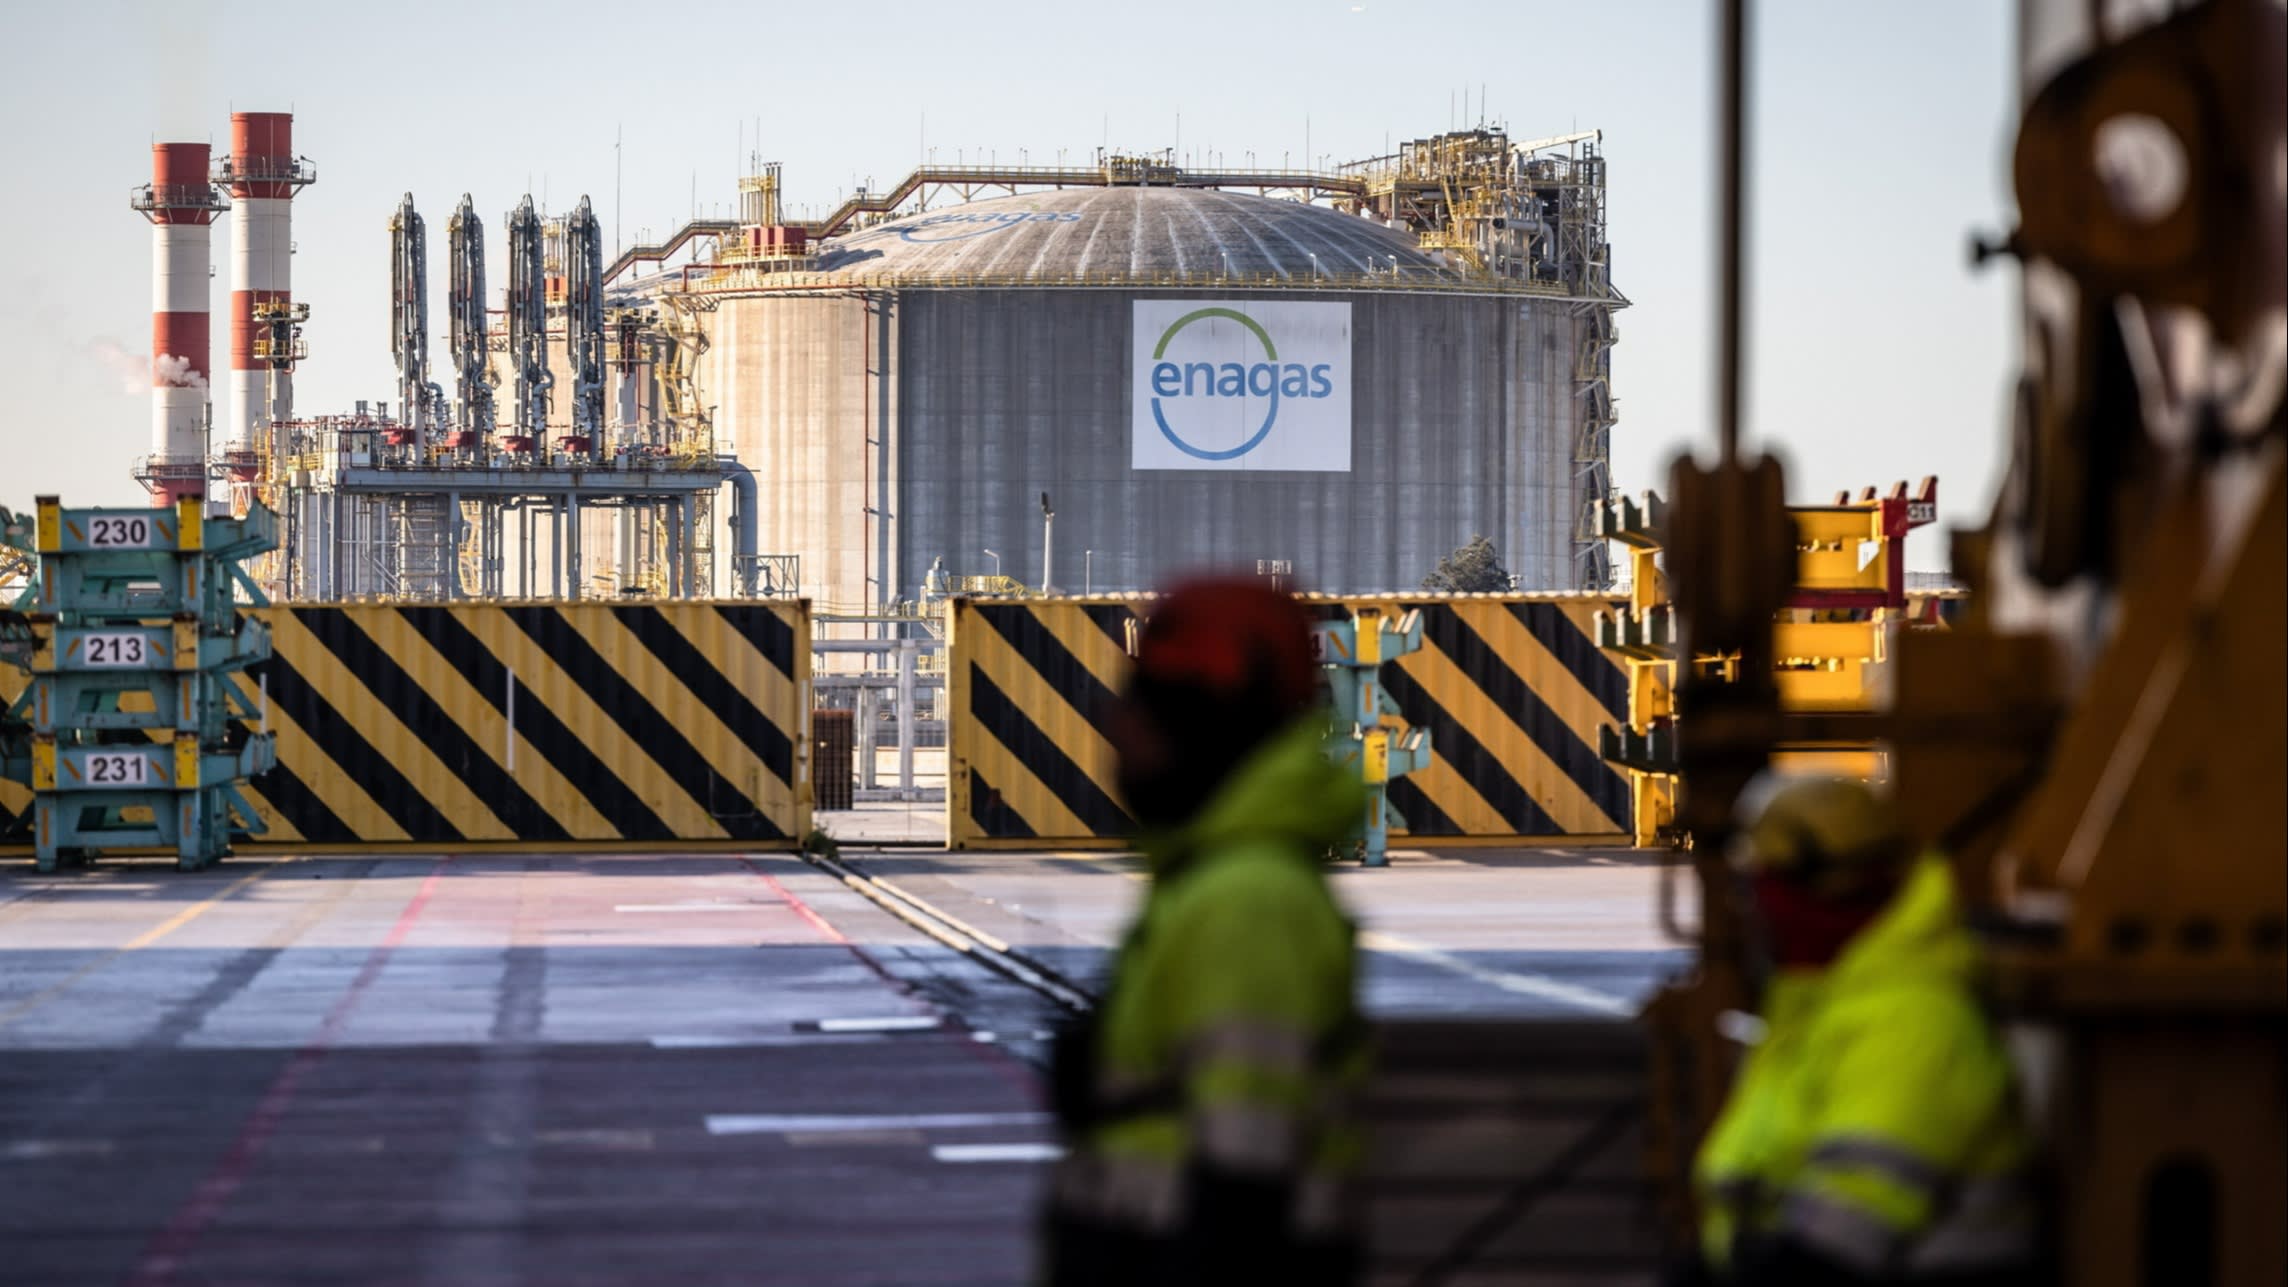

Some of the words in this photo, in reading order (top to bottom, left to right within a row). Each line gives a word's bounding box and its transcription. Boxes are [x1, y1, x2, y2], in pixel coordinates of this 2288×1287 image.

[1151, 362, 1332, 399] enagas
[92, 519, 146, 545] 230
[88, 637, 141, 662] 213
[91, 757, 144, 782] 231
